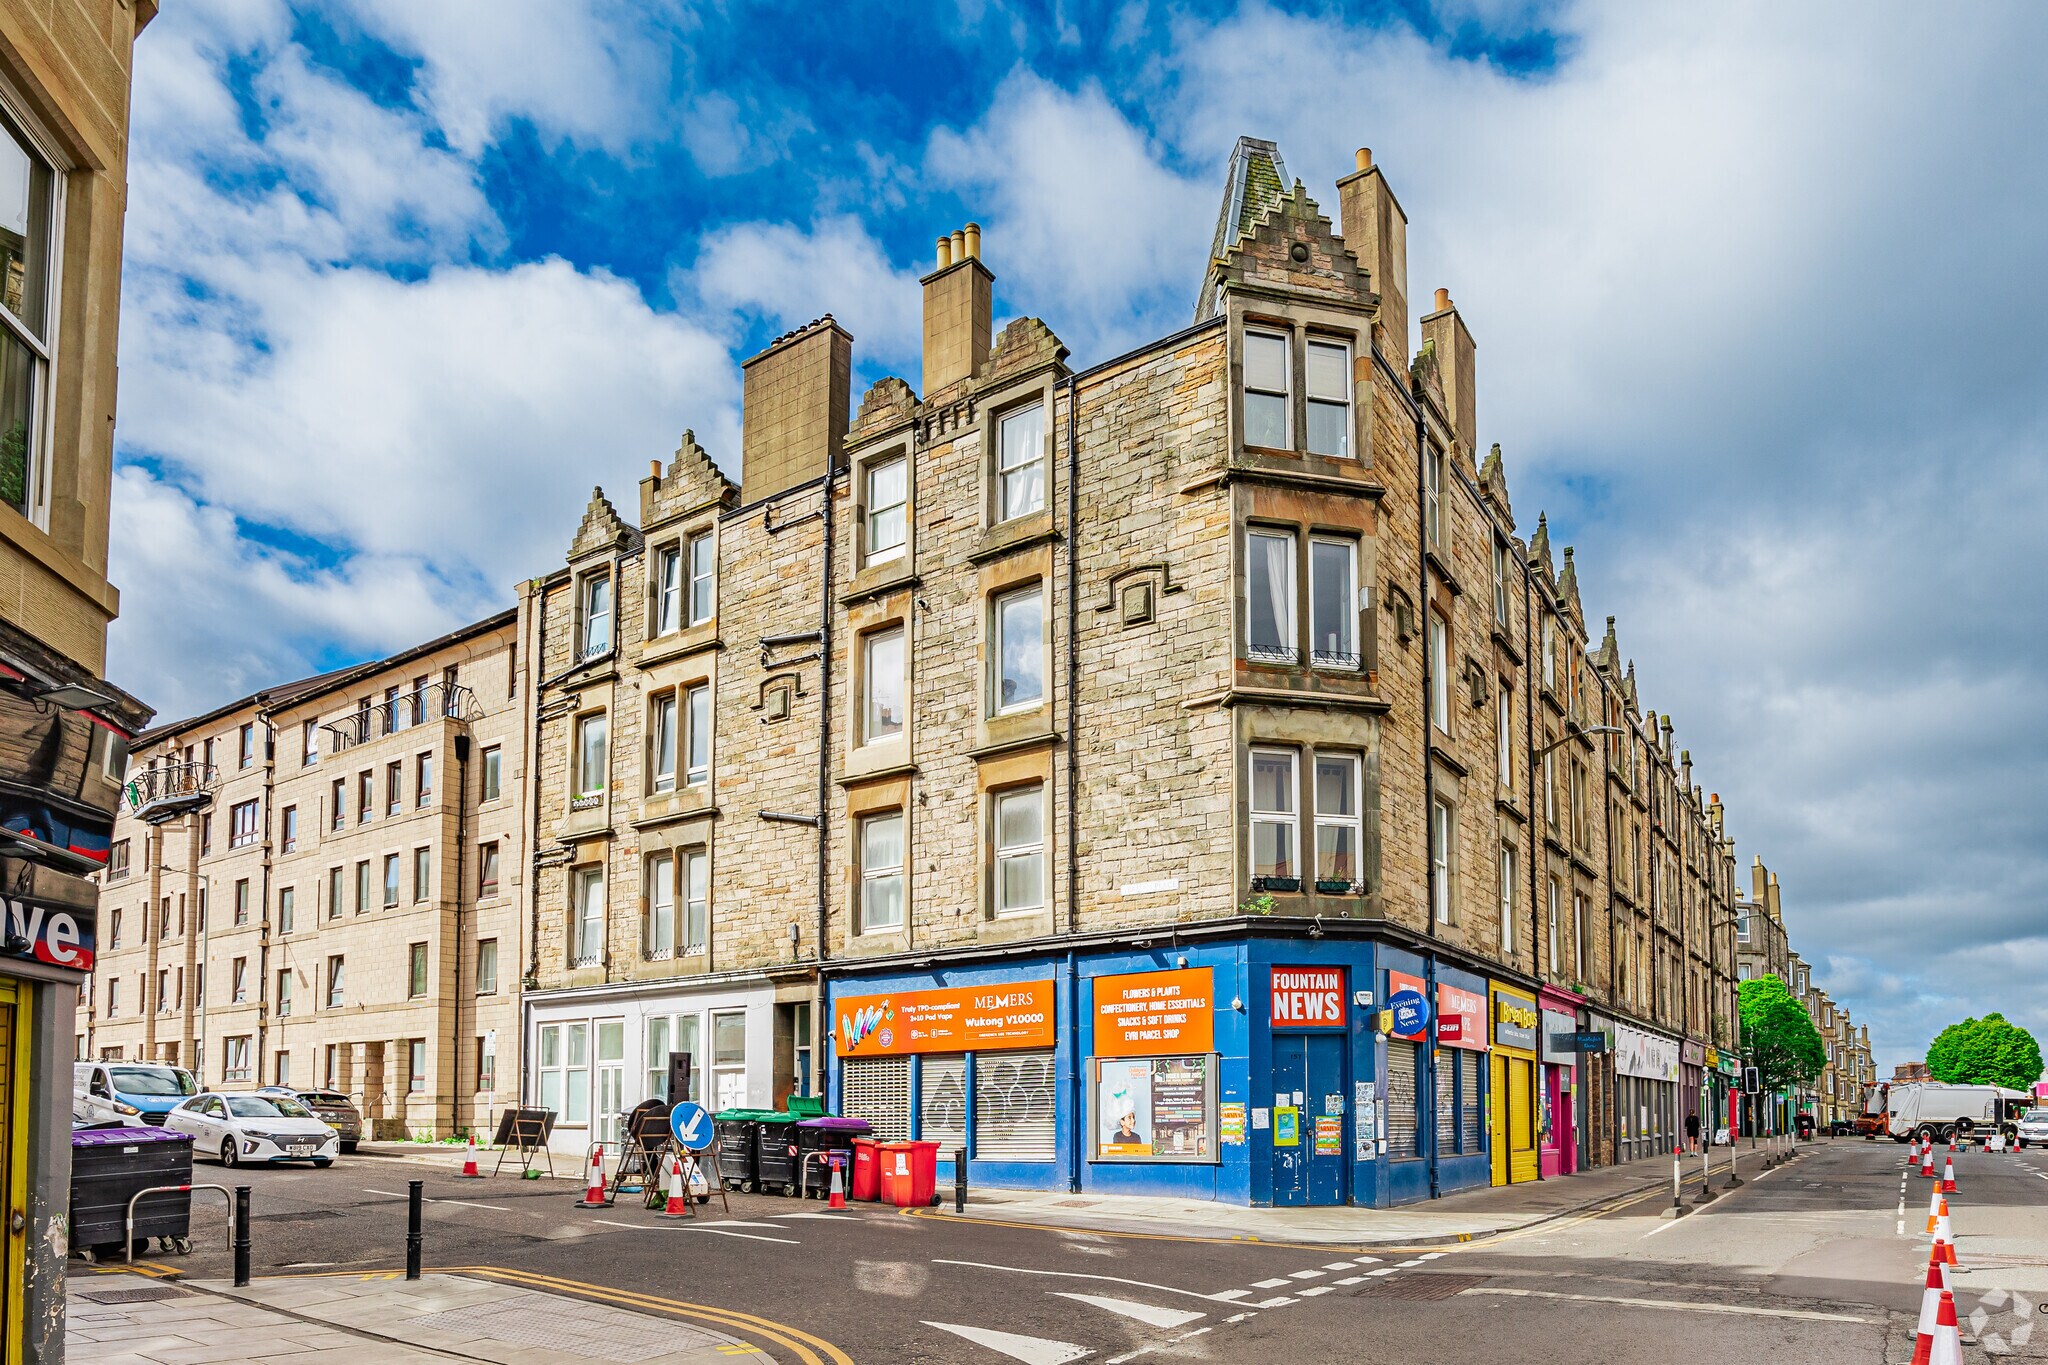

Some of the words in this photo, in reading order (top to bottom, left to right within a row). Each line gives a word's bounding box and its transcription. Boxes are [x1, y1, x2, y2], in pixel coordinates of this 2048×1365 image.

[1273, 973, 1338, 989] FOUNTAIN
[1122, 988, 1150, 999] FLOWERS
[1156, 985, 1180, 996] PLANTS
[901, 1005, 916, 1013] Truly
[917, 1002, 961, 1011] TPD-compliant
[974, 992, 1033, 1011] MEMERS
[1100, 1002, 1148, 1014] CONFECTIONERY,
[1149, 1000, 1166, 1011] HOME
[1167, 998, 1205, 1010] ESSENTIALS
[1273, 992, 1340, 1020] NEWS
[1390, 997, 1421, 1010] Evening
[1450, 993, 1477, 1014] MEMERS
[937, 1013, 953, 1021] Vape
[965, 1016, 1004, 1028] Wukong
[1005, 1012, 1044, 1025] V10000
[1117, 1016, 1141, 1027] SNACKS
[1147, 1015, 1163, 1025] SOFT
[1163, 1013, 1187, 1024] DRINKS
[1400, 1018, 1420, 1028] News
[1523, 1007, 1538, 1029] Boys
[1125, 1031, 1138, 1041] EVRI
[1139, 1029, 1162, 1040] PARCEL
[1163, 1028, 1180, 1039] SHOP
[1439, 1023, 1460, 1032] Sun
